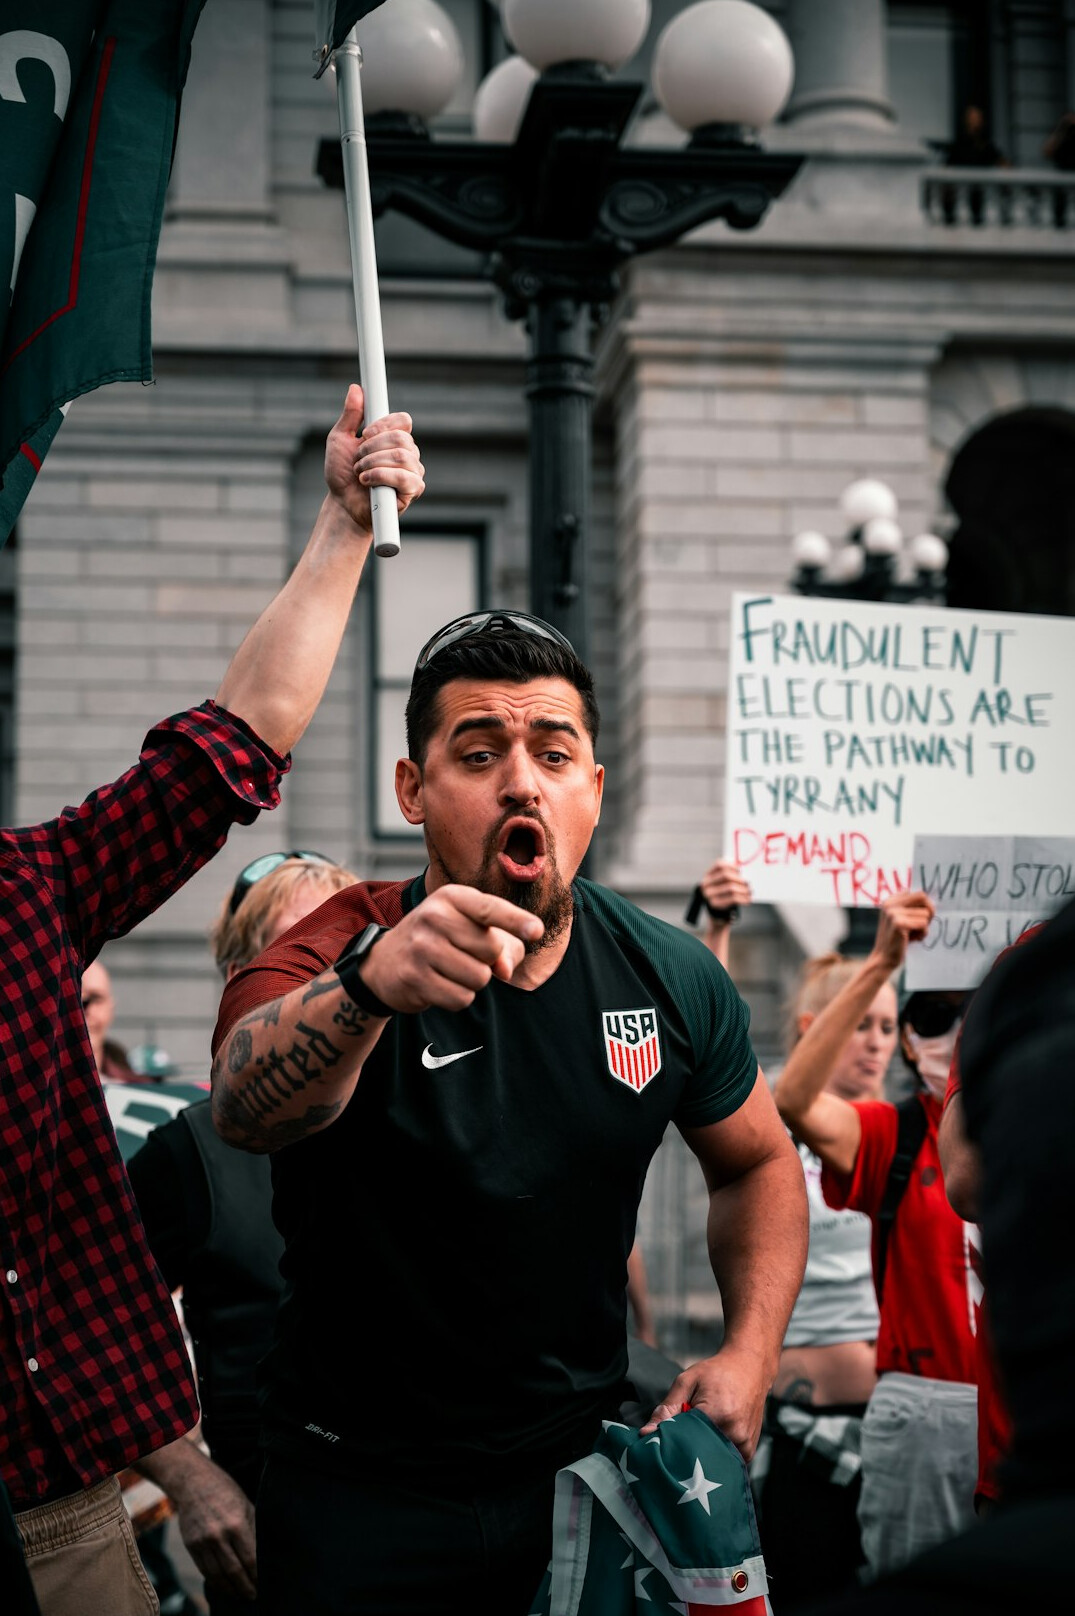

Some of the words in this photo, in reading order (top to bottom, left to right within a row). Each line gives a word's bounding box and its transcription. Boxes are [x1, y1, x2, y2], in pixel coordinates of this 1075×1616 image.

[739, 597, 1017, 686] FRAUDULENT
[737, 673, 956, 725] ELECTIONS
[969, 687, 1054, 728] ARE
[735, 728, 805, 765] THE
[823, 729, 974, 777] PATHWAY
[989, 741, 1036, 774] TO
[735, 774, 905, 827] TYRRANY
[733, 828, 871, 867] DEMAND
[919, 861, 999, 901] WHO
[605, 1012, 655, 1045] USA
[304, 1423, 340, 1443] DRI-FIT
